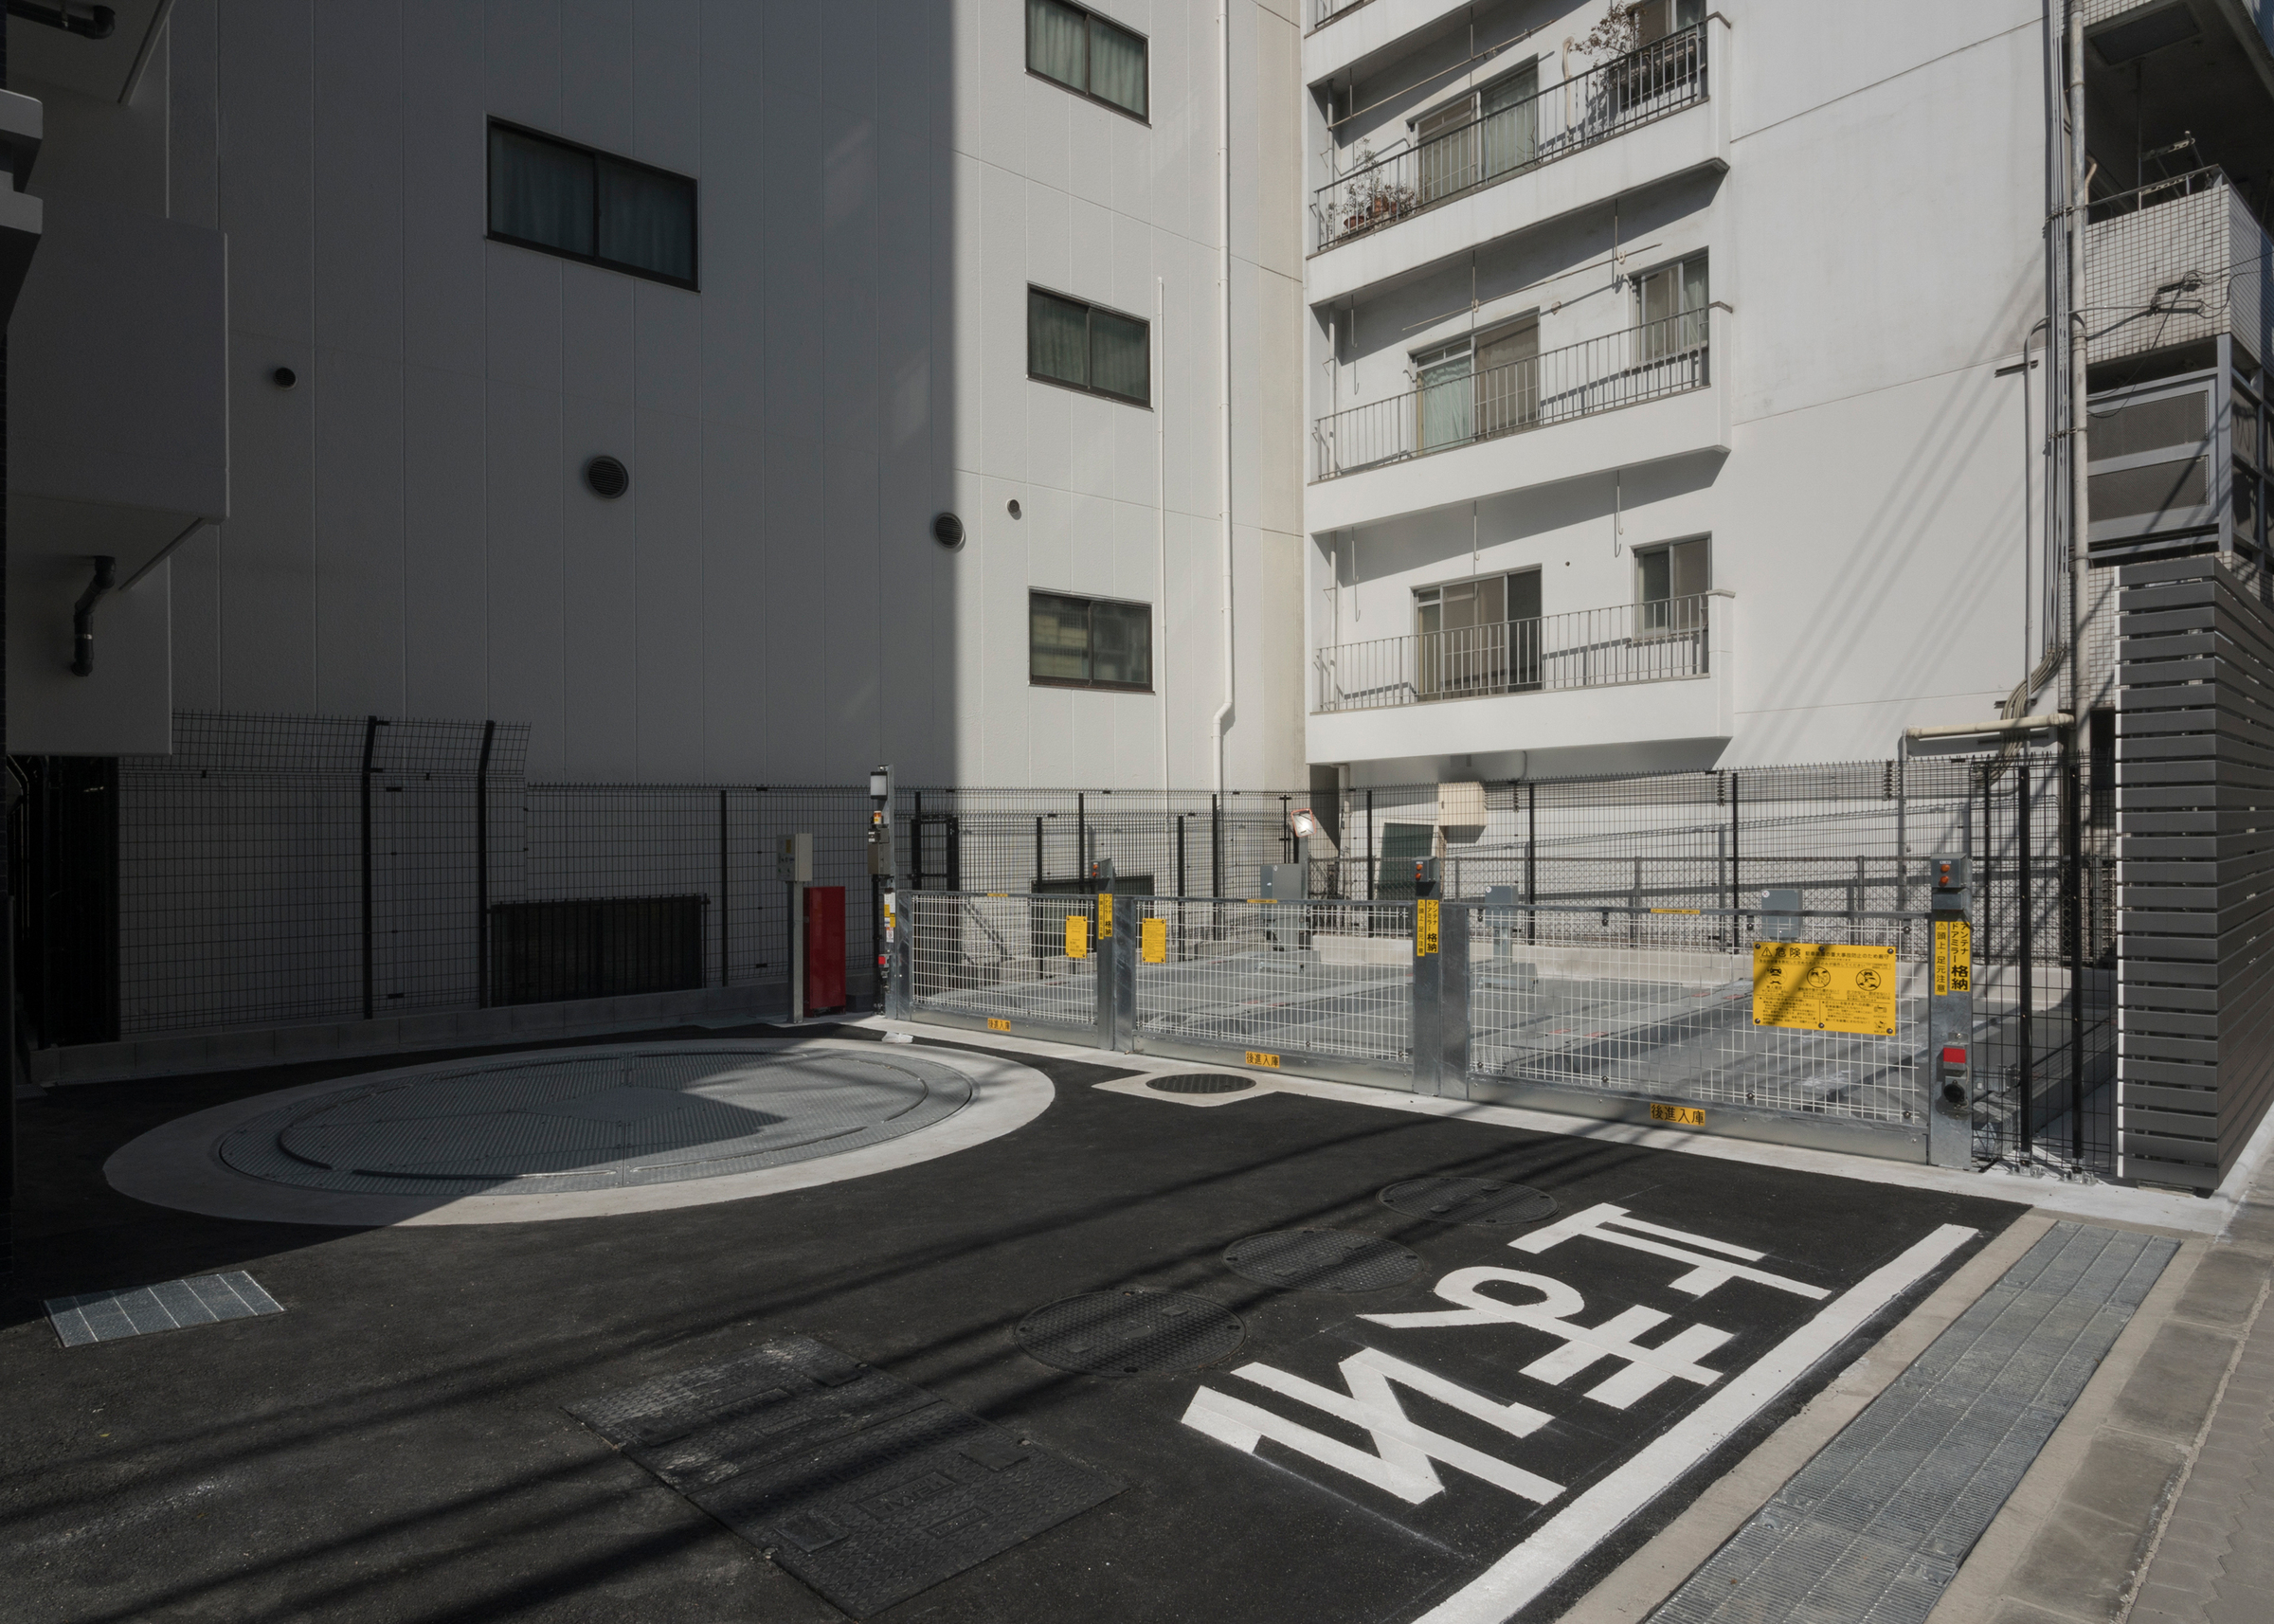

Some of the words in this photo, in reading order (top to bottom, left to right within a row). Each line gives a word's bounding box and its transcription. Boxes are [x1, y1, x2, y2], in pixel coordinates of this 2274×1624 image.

[1427, 932, 1437, 952] 格納
[1951, 923, 1959, 963] ドアミラー
[1960, 923, 1969, 955] アンテナ
[1775, 947, 1801, 958] 危険
[1937, 931, 1946, 992] 頭上・足元注意
[1951, 965, 1969, 990] 格納
[1246, 1052, 1278, 1067] 後進入庫
[1651, 1104, 1705, 1125] 後進入庫
[1181, 1201, 1832, 1504] 止まれ
